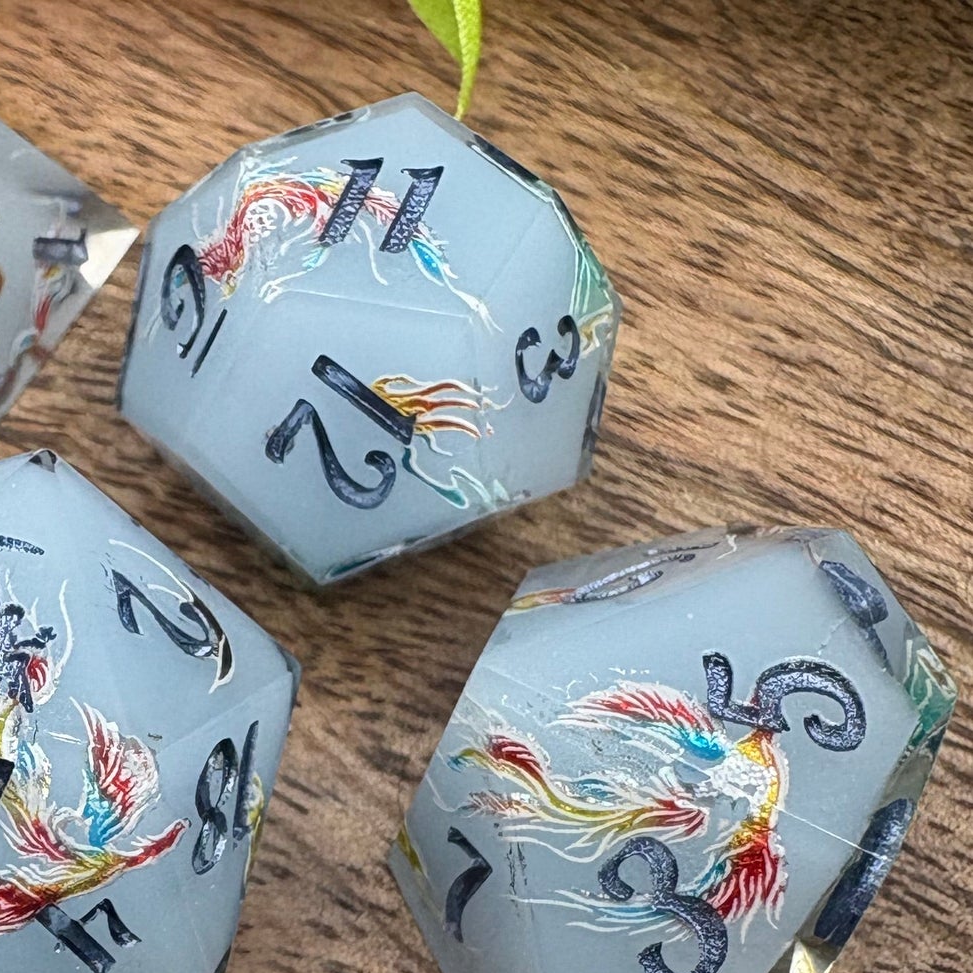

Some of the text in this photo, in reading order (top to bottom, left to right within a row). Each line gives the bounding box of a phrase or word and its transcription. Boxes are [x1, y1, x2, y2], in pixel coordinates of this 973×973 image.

[319, 157, 445, 254] 11
[515, 315, 580, 404] 3
[265, 354, 417, 510] 12
[703, 650, 867, 752] 5
